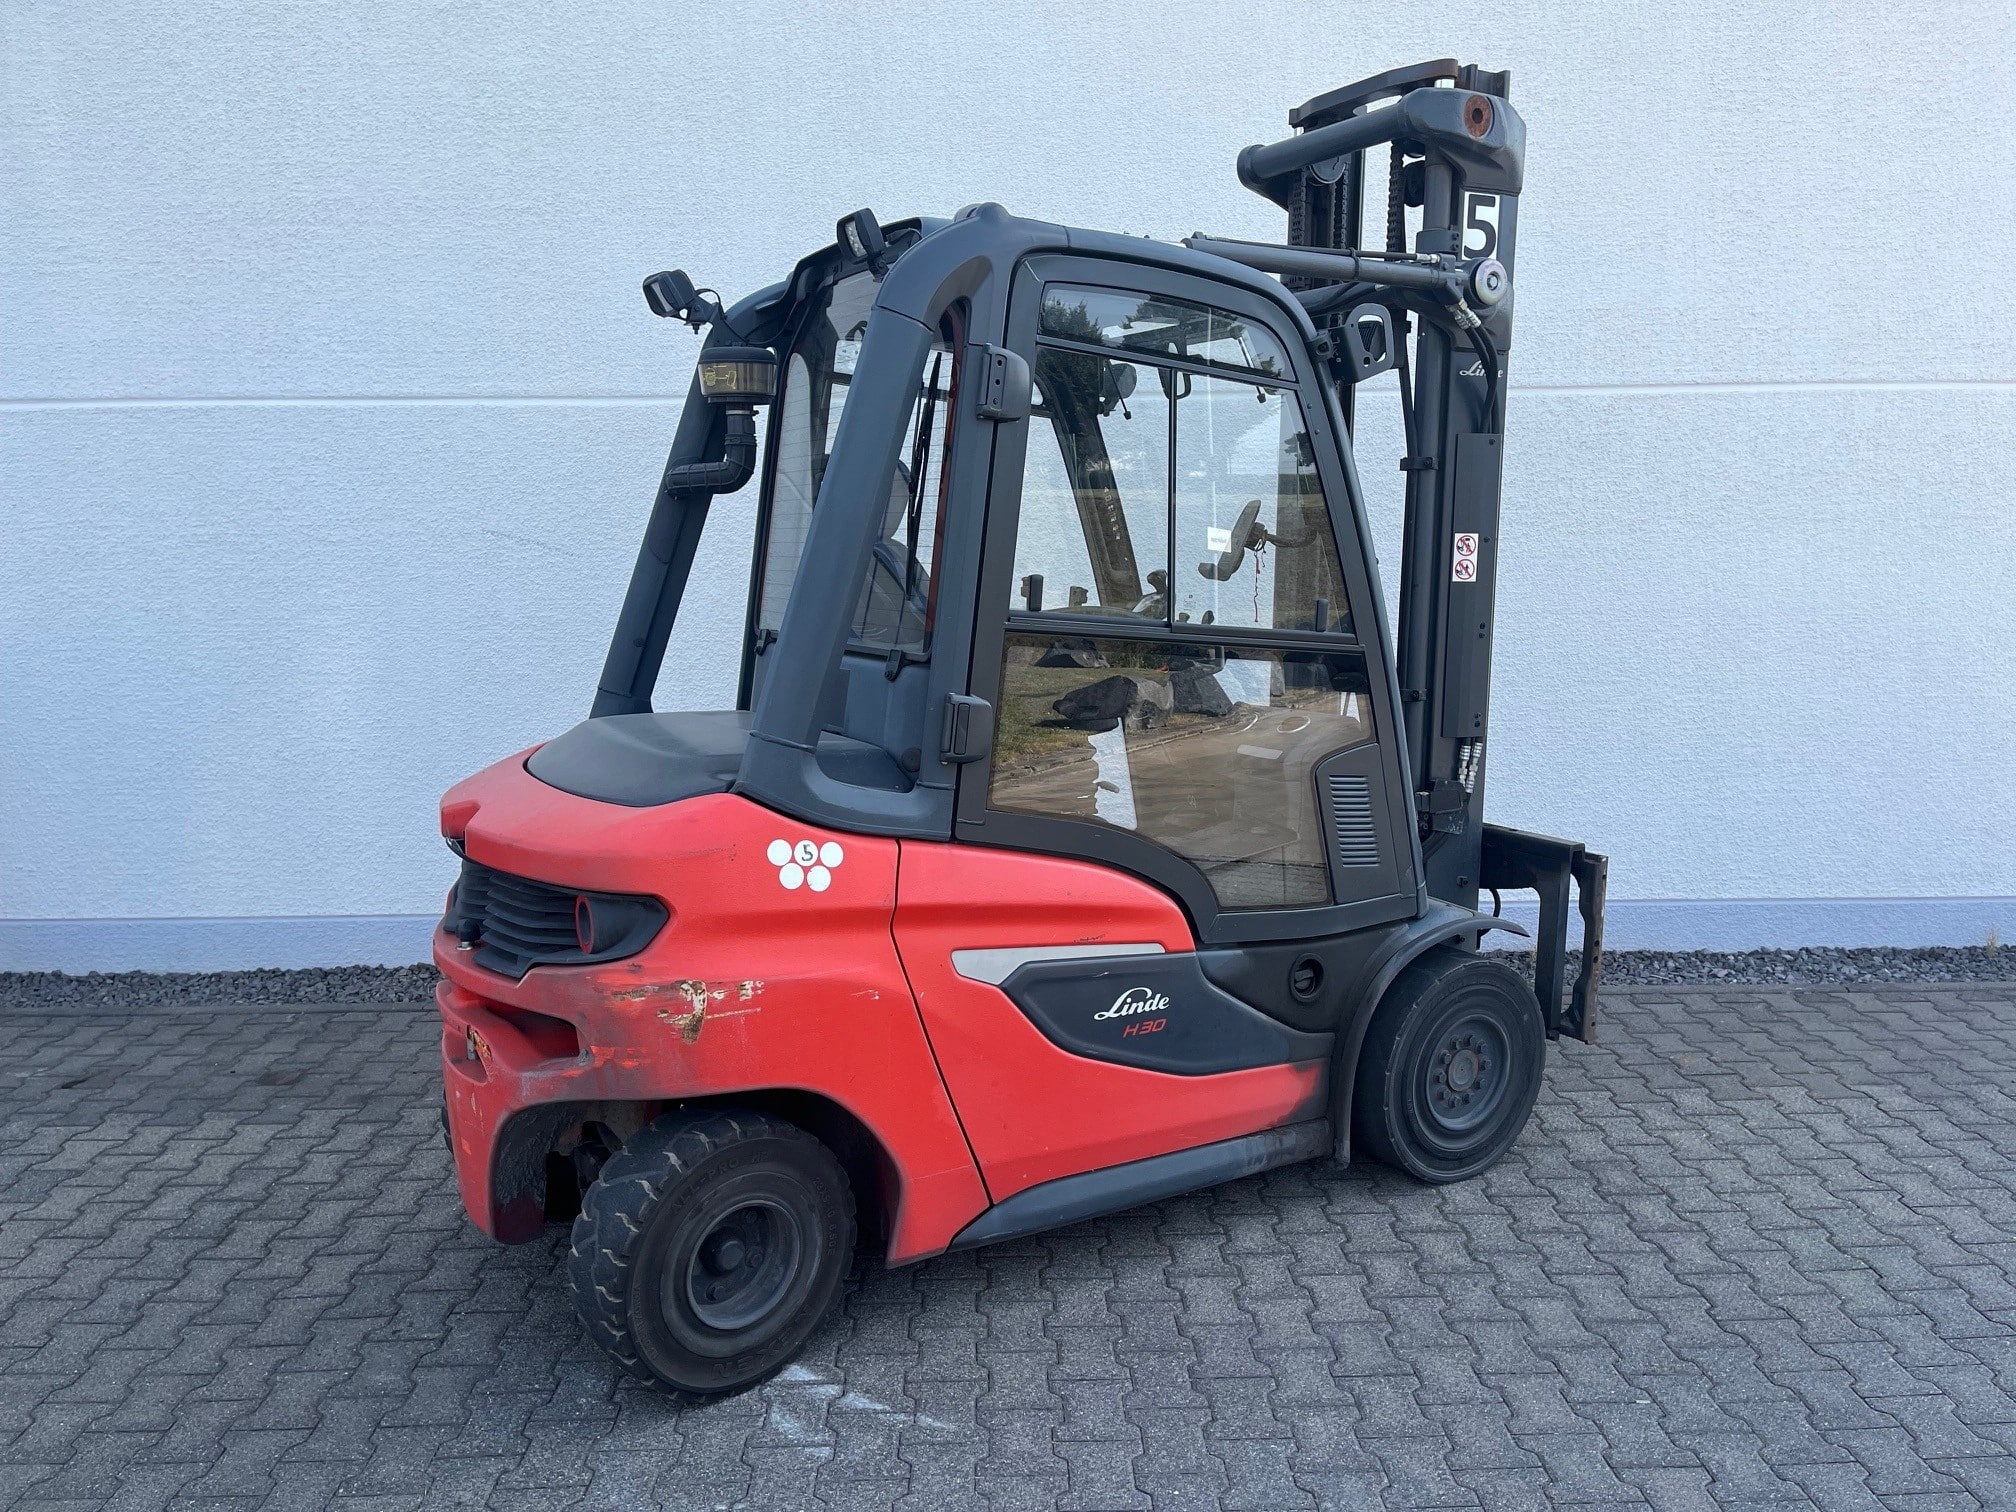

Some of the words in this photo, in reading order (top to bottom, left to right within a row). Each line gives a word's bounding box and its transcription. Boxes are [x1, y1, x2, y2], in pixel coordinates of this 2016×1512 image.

[1464, 194, 1497, 259] 5
[801, 844, 814, 861] 5
[1093, 986, 1170, 1021] Linde
[1121, 1018, 1167, 1038] H30
